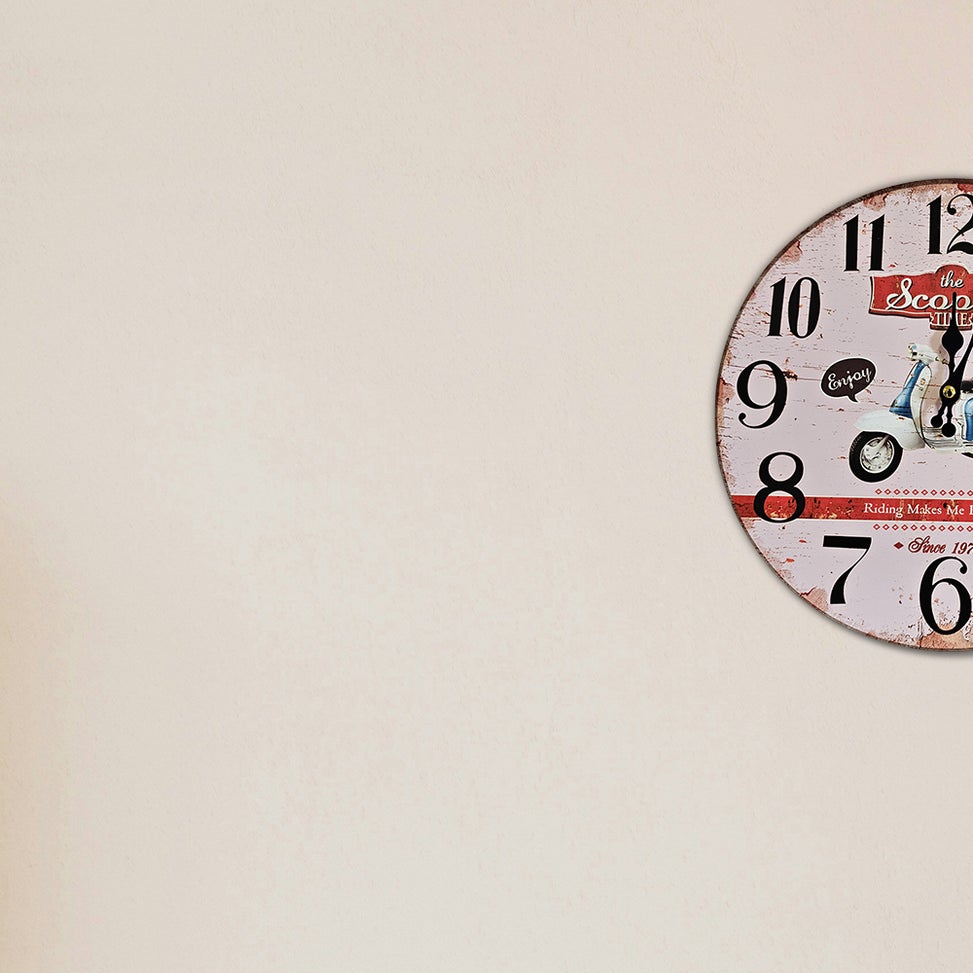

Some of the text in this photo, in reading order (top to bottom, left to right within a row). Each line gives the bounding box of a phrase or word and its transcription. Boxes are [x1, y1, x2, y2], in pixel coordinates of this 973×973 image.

[843, 214, 885, 272] 11
[769, 276, 821, 339] 10
[940, 270, 964, 288] the
[736, 360, 789, 429] 9
[827, 367, 872, 390] Enjoy
[753, 451, 806, 524] 8
[864, 502, 903, 518] Riding
[907, 503, 942, 515] Makes
[946, 504, 965, 516] Me
[822, 535, 872, 605] 7
[908, 536, 946, 554] Since
[919, 556, 973, 636] 6
